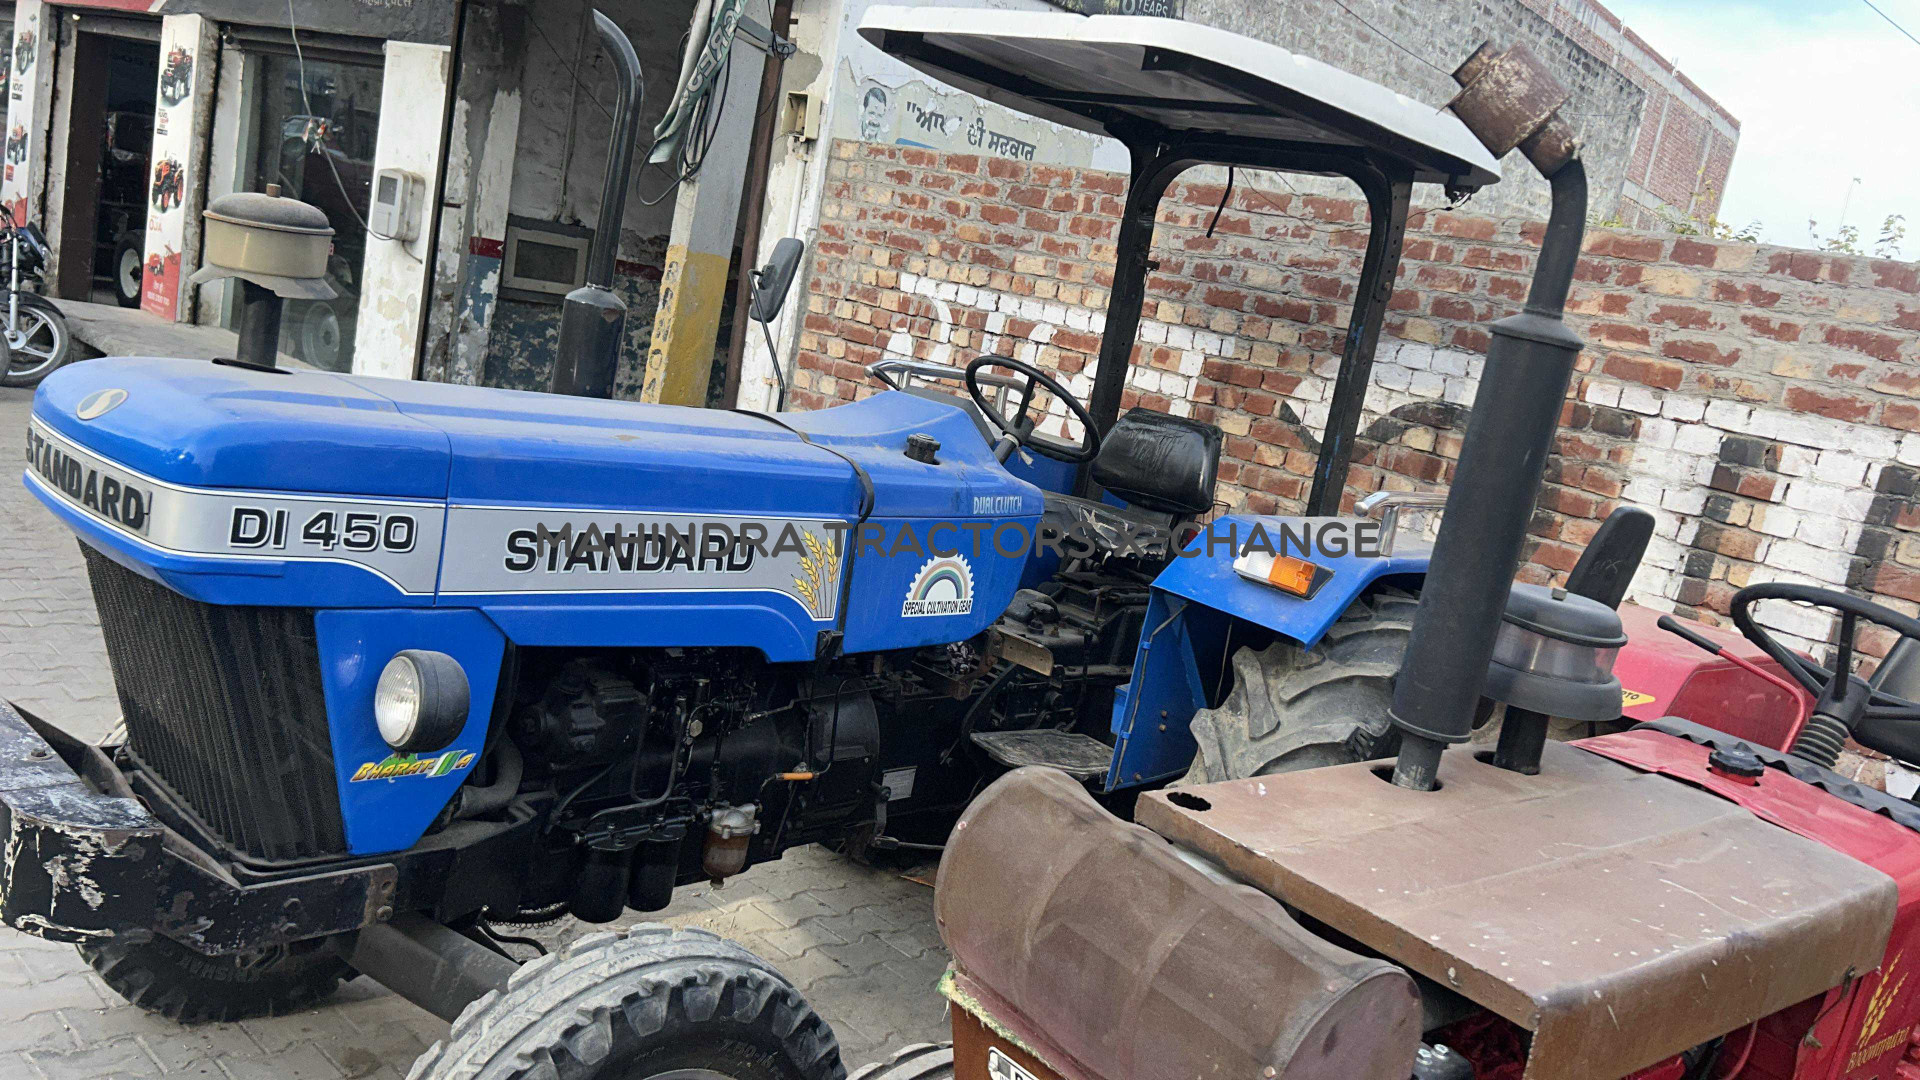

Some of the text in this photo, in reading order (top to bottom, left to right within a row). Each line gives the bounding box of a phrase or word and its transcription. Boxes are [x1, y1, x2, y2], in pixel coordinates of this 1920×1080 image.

[26, 426, 145, 530] STANDARD
[973, 496, 1023, 515] DUAL CLUTCH
[227, 505, 418, 553] DI 450
[504, 528, 757, 574] STANDARD
[903, 599, 972, 615] SPECIAL CULTIVATION GEAR
